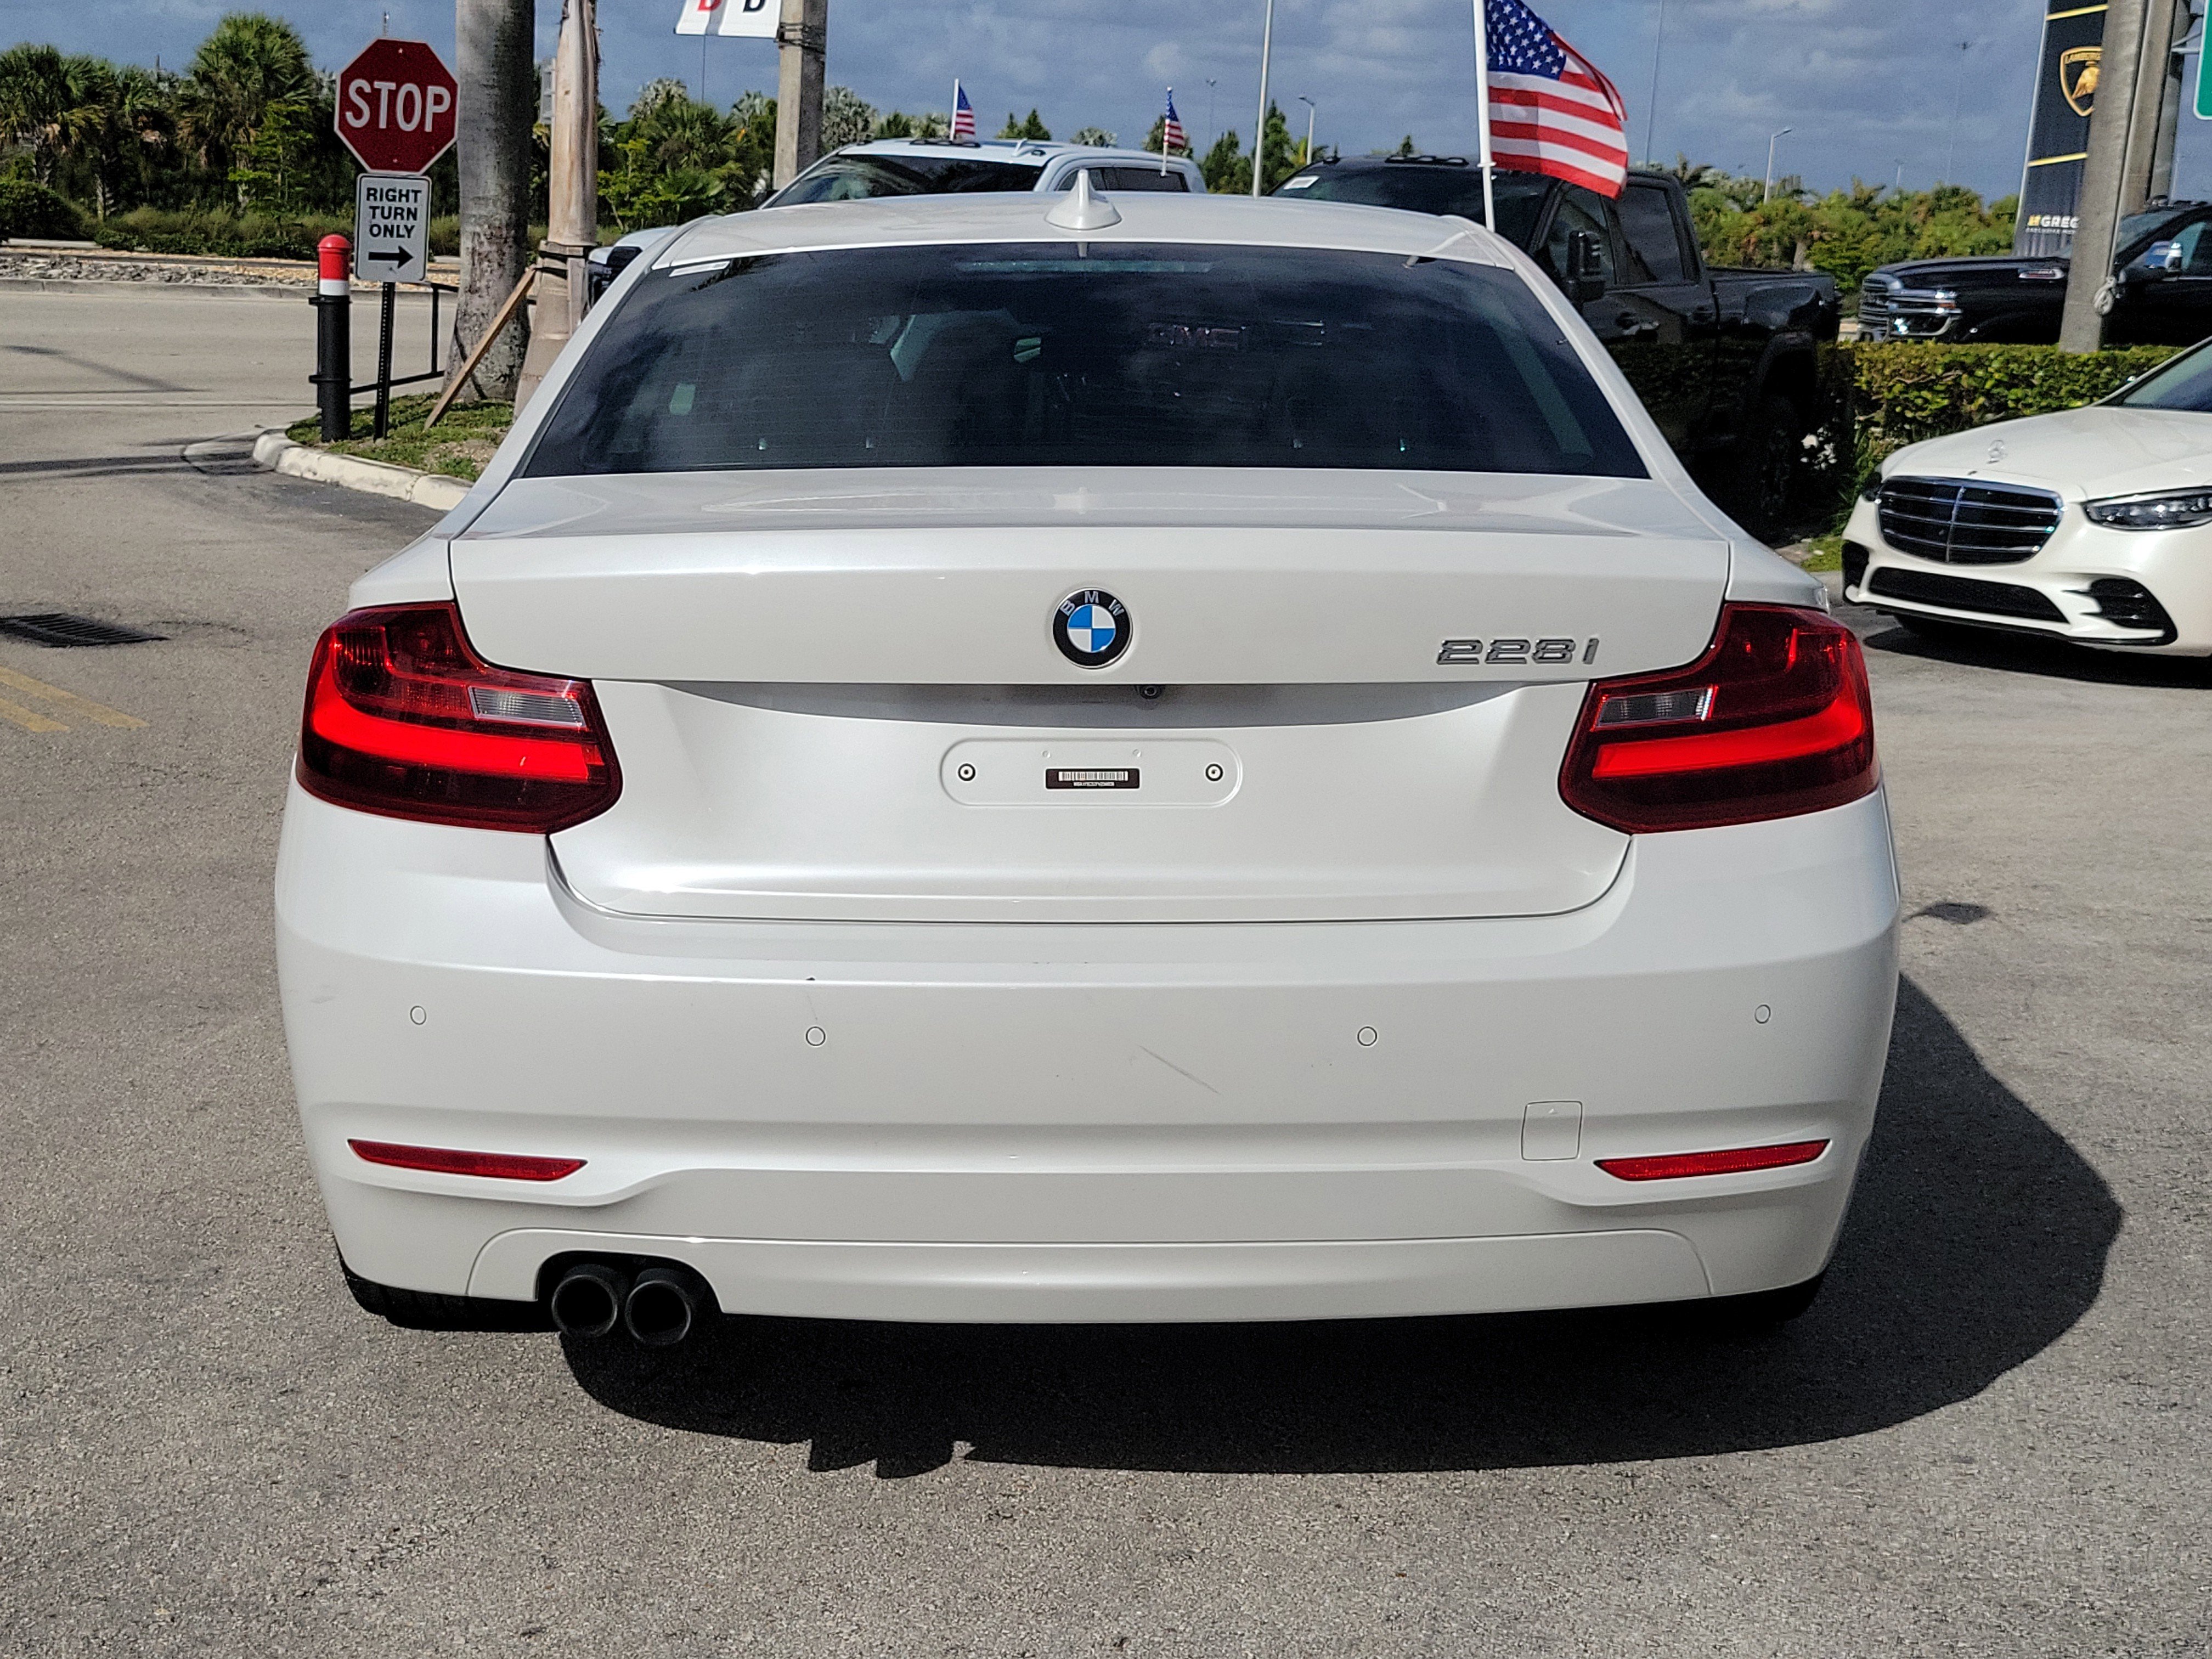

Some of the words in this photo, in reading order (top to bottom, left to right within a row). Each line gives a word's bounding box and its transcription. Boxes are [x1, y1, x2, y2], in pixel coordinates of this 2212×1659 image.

[345, 78, 451, 133] STOP
[366, 187, 422, 204] RIGHT
[369, 206, 418, 221] TURN
[369, 223, 416, 239] ONLY
[1059, 590, 1125, 616] BMW
